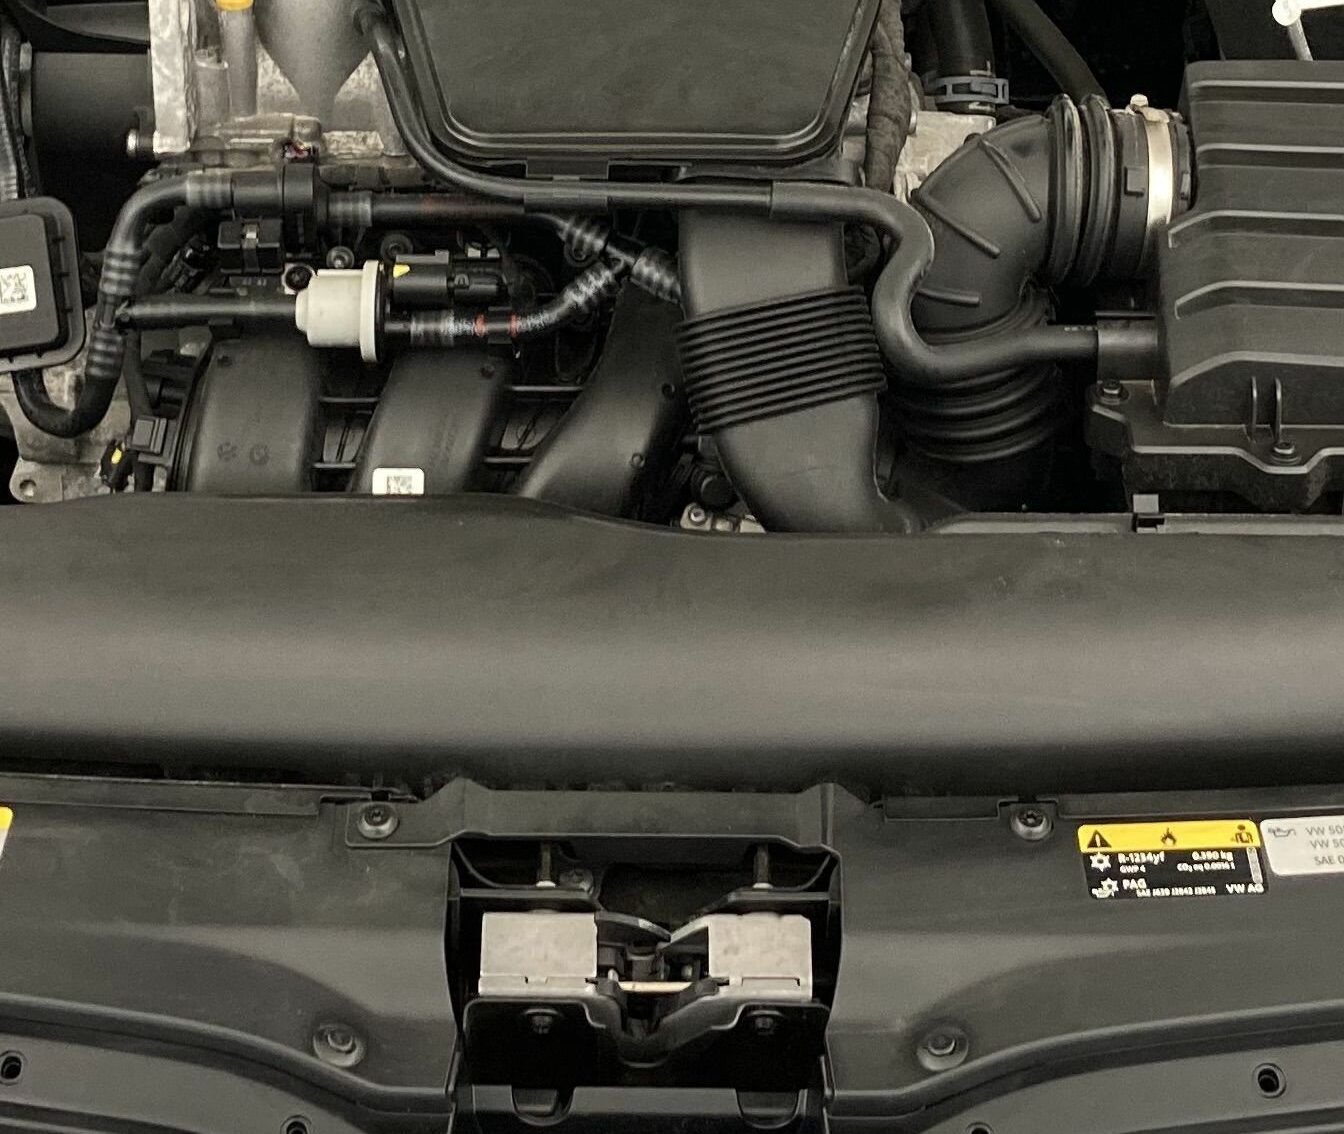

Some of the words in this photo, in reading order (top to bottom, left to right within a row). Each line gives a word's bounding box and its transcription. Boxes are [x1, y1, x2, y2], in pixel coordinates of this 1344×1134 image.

[1305, 826, 1325, 836] VW
[1310, 839, 1329, 849] VW
[1220, 850, 1233, 862] kg
[1314, 856, 1335, 865] SAE
[1122, 878, 1147, 890] PAG
[1226, 883, 1245, 894] VW
[1247, 883, 1264, 893] AG
